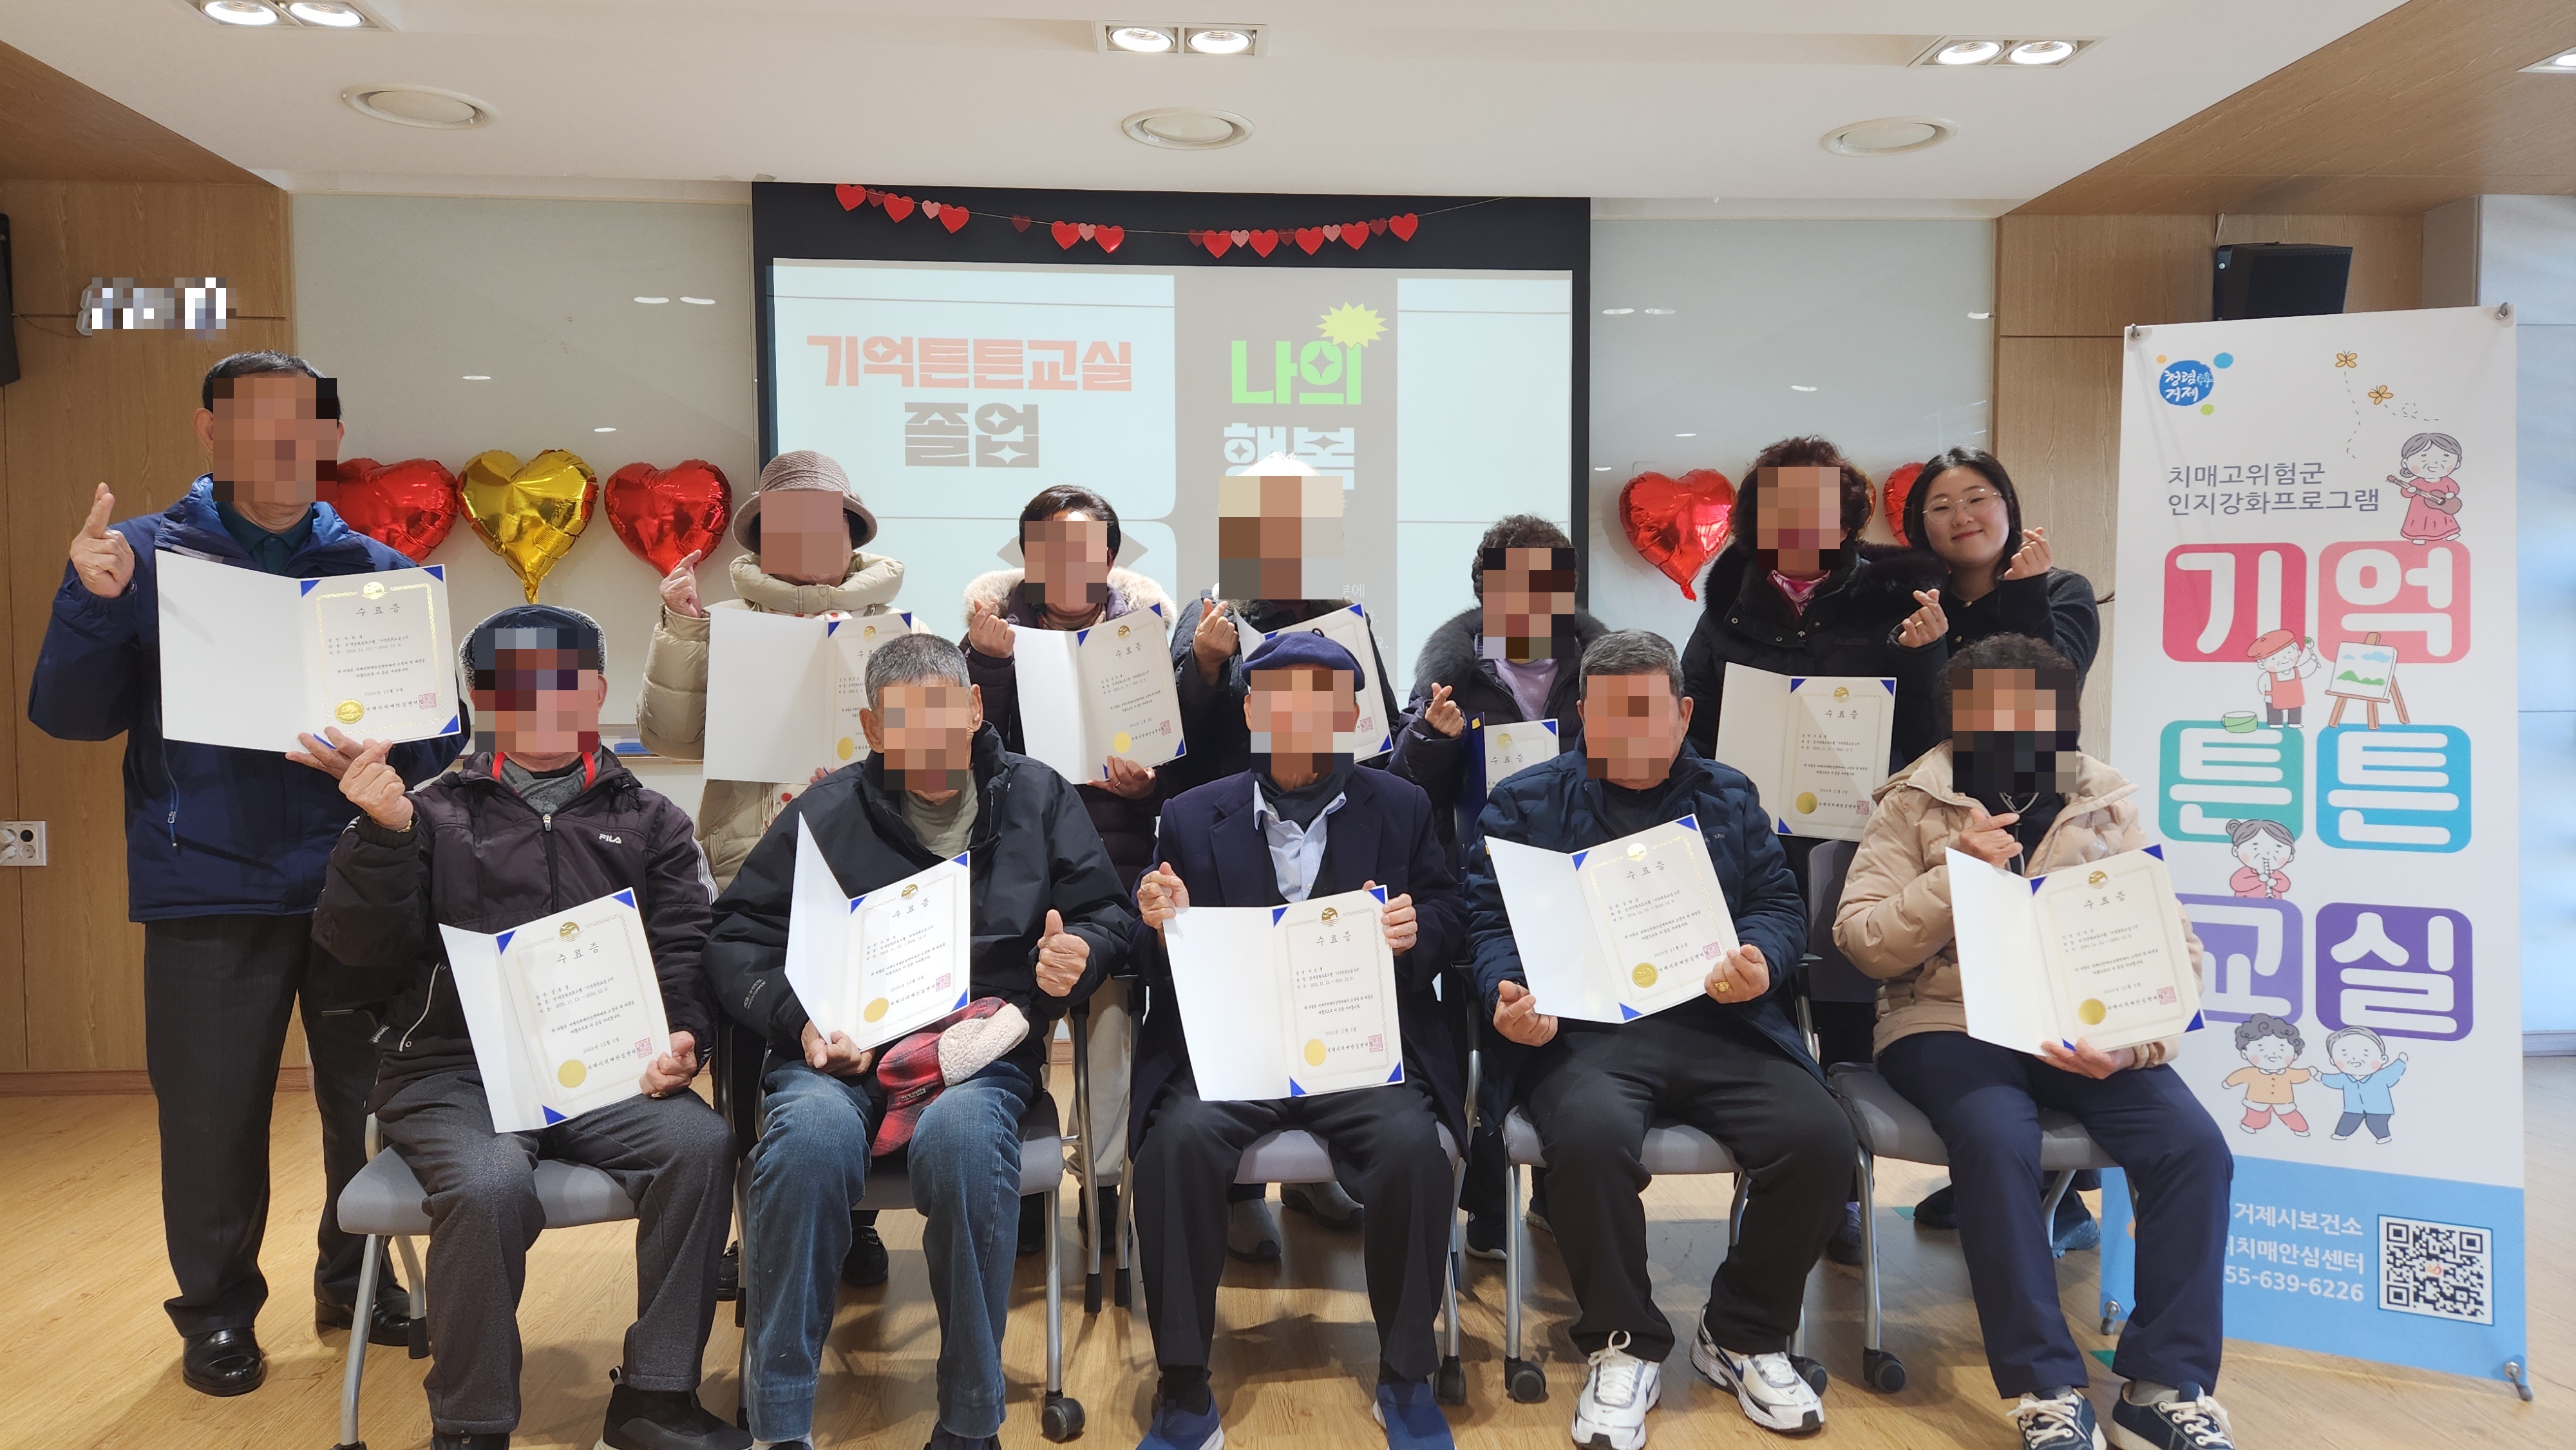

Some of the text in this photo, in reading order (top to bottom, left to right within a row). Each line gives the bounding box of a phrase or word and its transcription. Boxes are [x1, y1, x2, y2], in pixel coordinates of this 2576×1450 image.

[806, 335, 1132, 391] 기억튼튼교실
[1231, 339, 1362, 405] 나의
[2164, 386, 2199, 402] 거제
[904, 401, 1039, 468] 졸업
[2168, 462, 2326, 489] 치매고위험군
[2168, 488, 2380, 516] 인지강화프로그램
[2175, 546, 2453, 657] 기억
[2169, 727, 2460, 845] 튼튼
[599, 833, 622, 844] FILA
[1625, 860, 1665, 880] 수료증
[556, 941, 600, 965] 수료증
[1316, 930, 1352, 946] 수료증
[2181, 903, 2458, 1034] 교실
[2234, 1202, 2364, 1237] 거제시보건소
